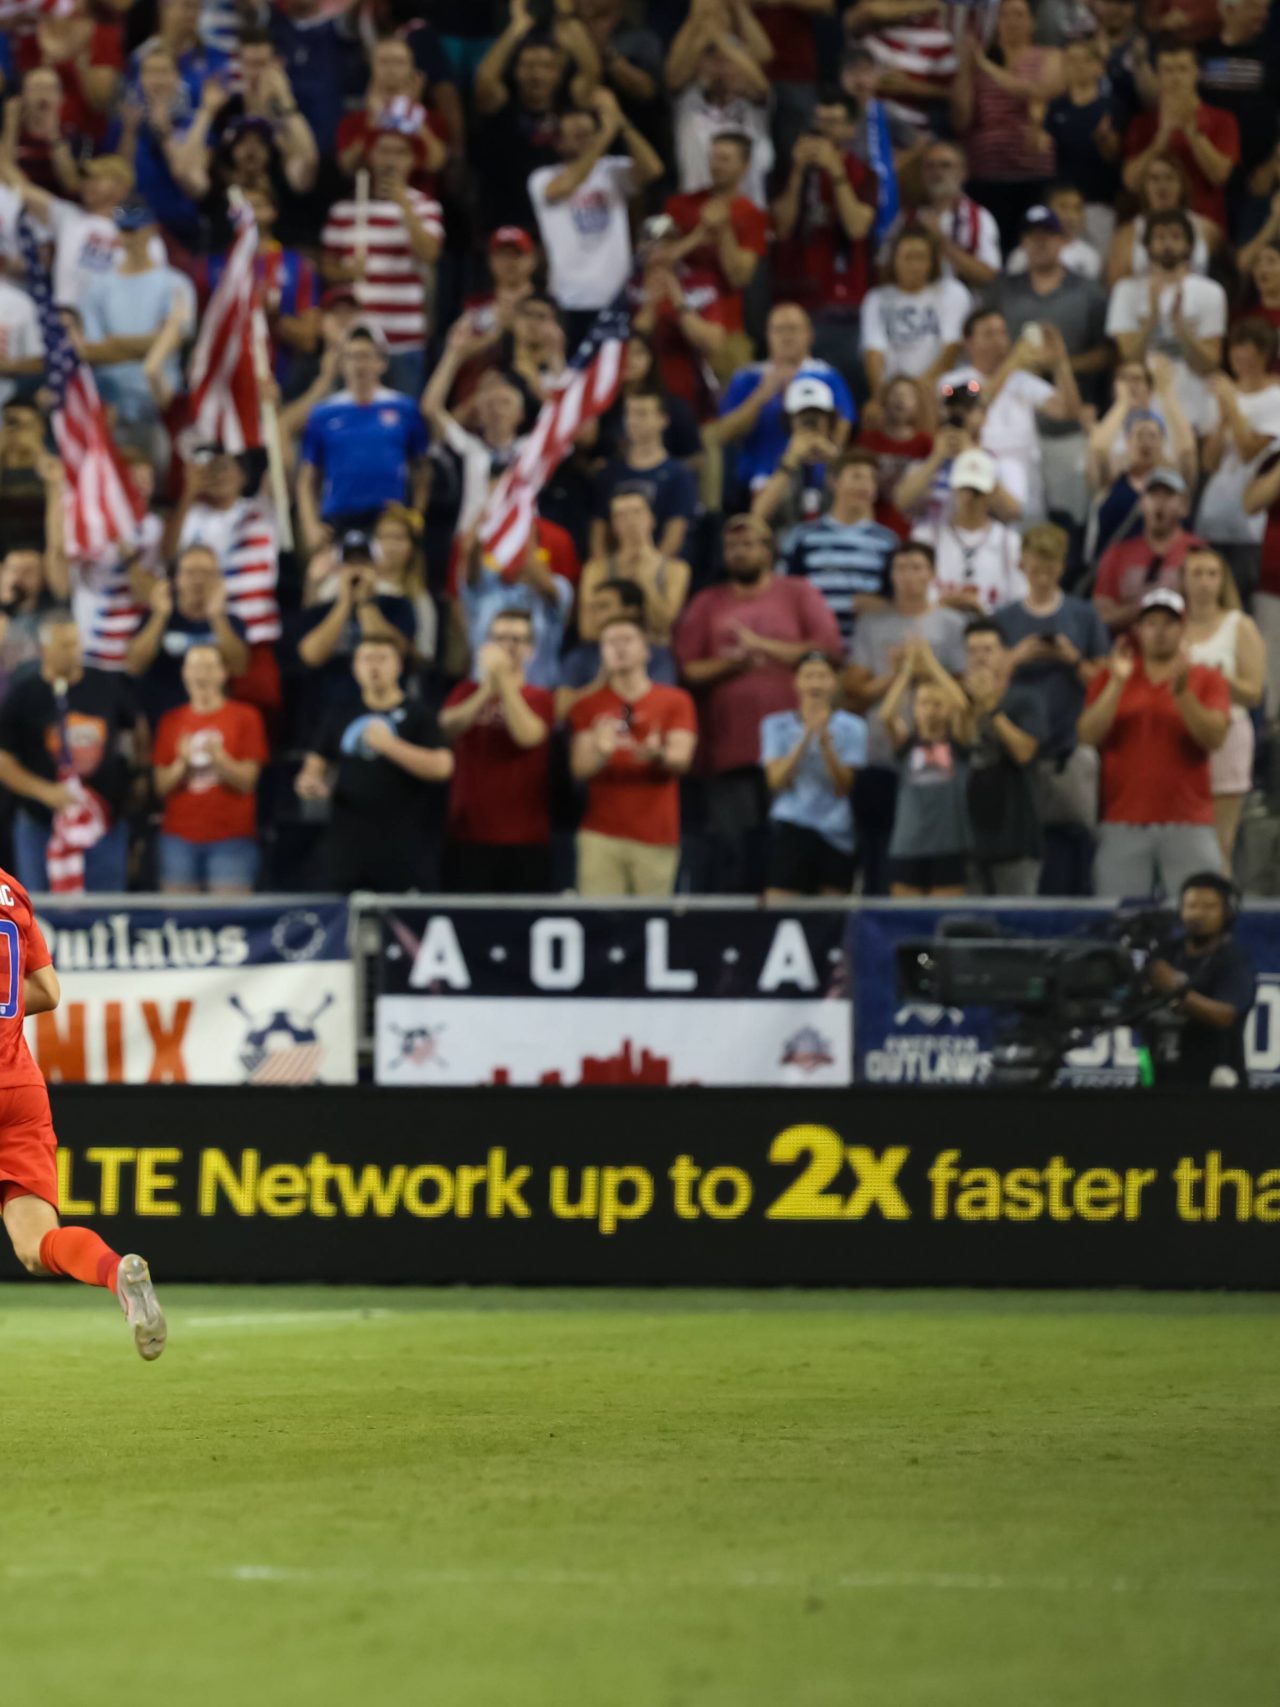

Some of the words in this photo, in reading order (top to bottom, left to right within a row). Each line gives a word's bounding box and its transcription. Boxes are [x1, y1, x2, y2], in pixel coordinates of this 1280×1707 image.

[56, 1147, 181, 1217] LTE
[197, 1148, 531, 1218] Network
[549, 1166, 654, 1234] up
[669, 1155, 753, 1219] to
[765, 1124, 910, 1219] 2x
[927, 1150, 1156, 1220] faster
